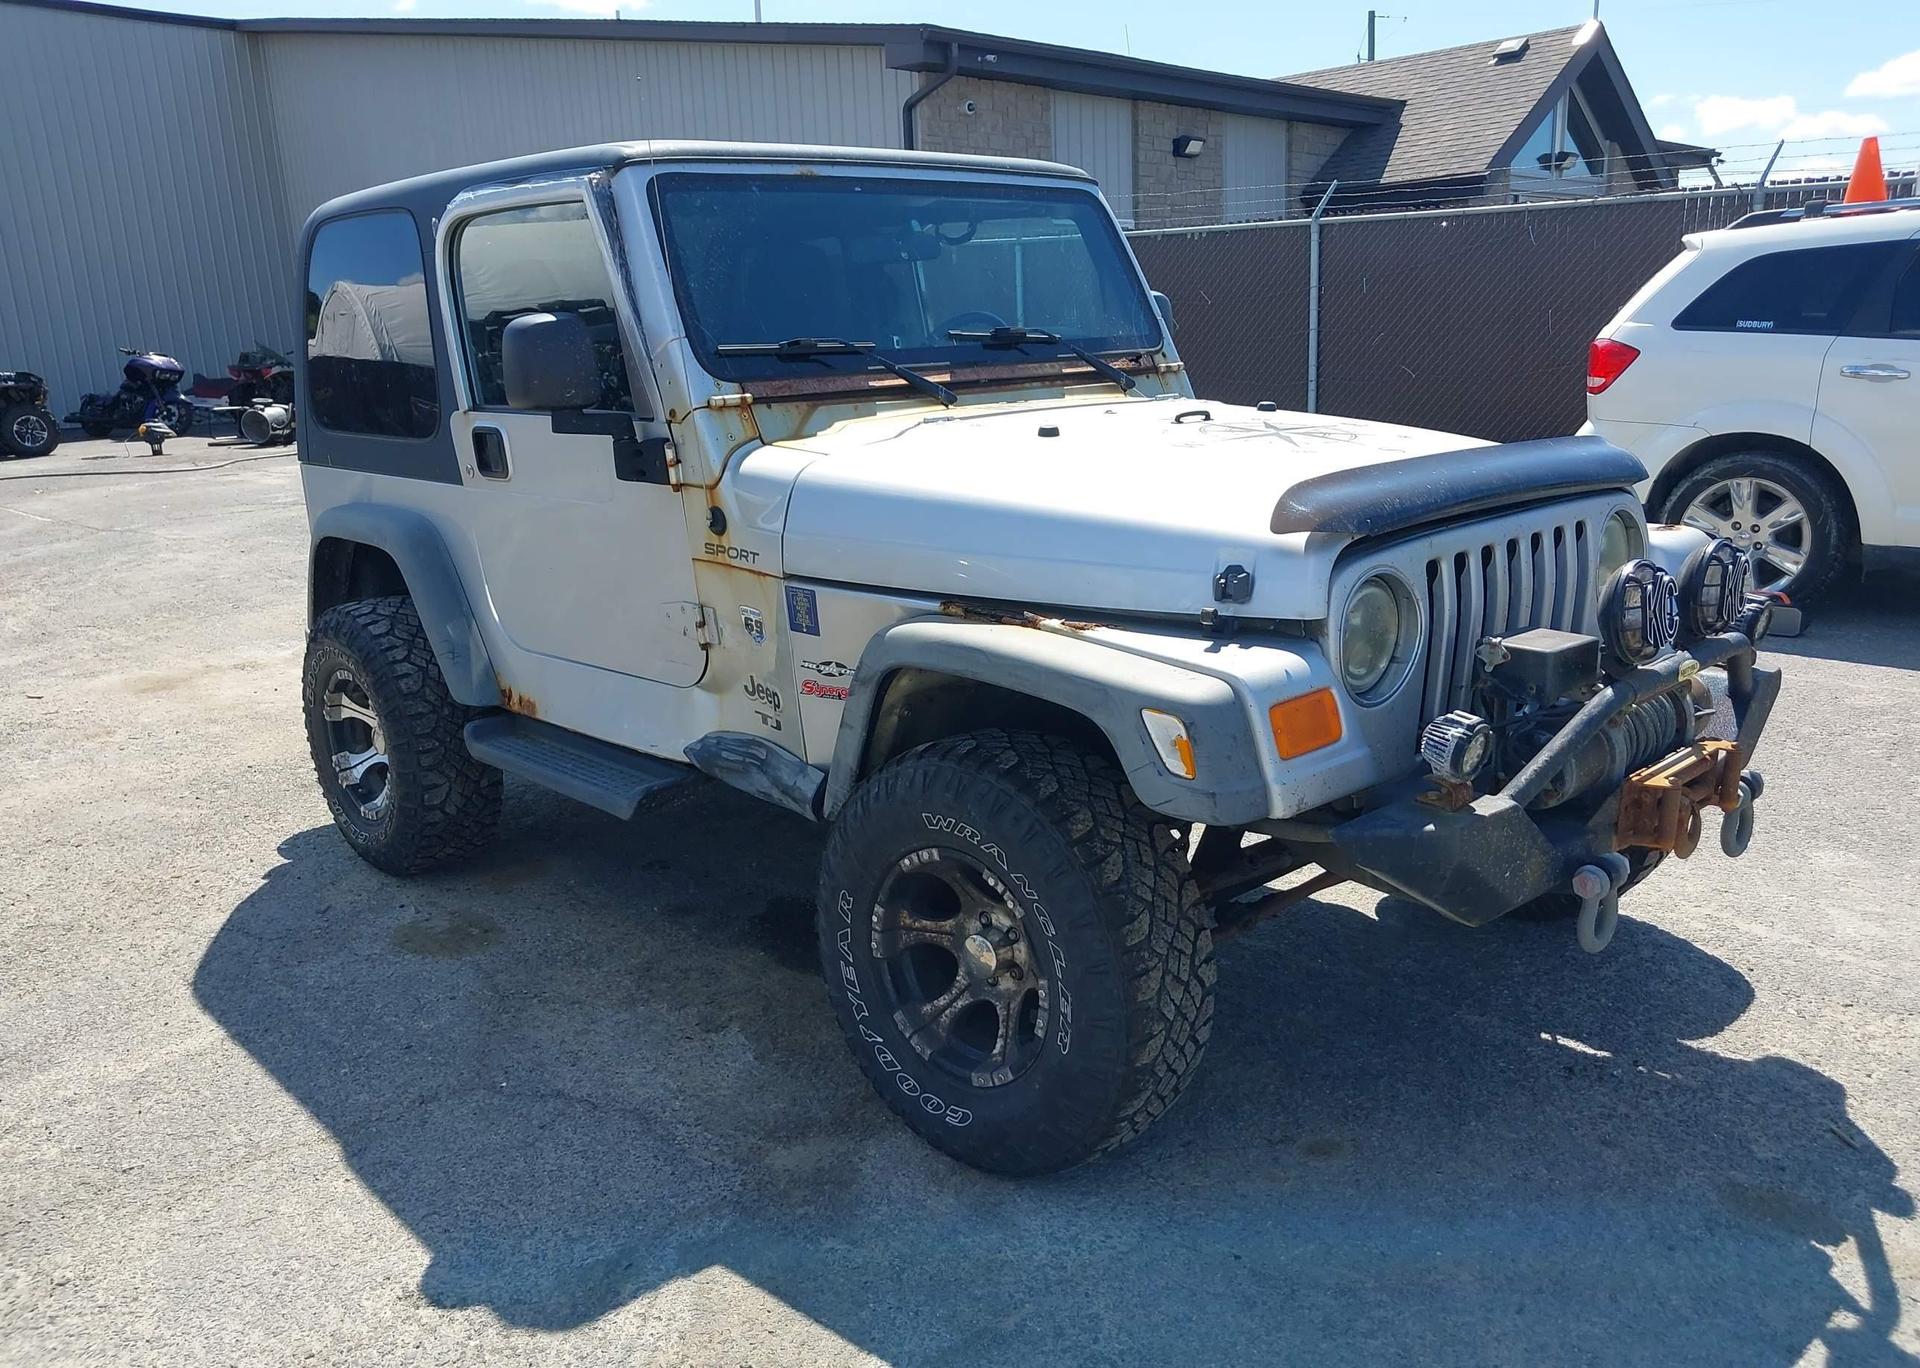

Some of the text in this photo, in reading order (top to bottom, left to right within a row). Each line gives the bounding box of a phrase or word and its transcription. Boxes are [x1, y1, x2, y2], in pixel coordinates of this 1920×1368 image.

[1736, 320, 1774, 329] (SUDBURY)
[704, 542, 760, 564] SPORT
[1723, 552, 1751, 624] KC
[1646, 571, 1680, 648] KC
[744, 675, 781, 712] Jeep
[801, 679, 849, 700] Synerg
[755, 710, 782, 731] TJ
[922, 812, 1072, 1055] WRANGLER
[837, 889, 973, 1127] GOODYEAR
